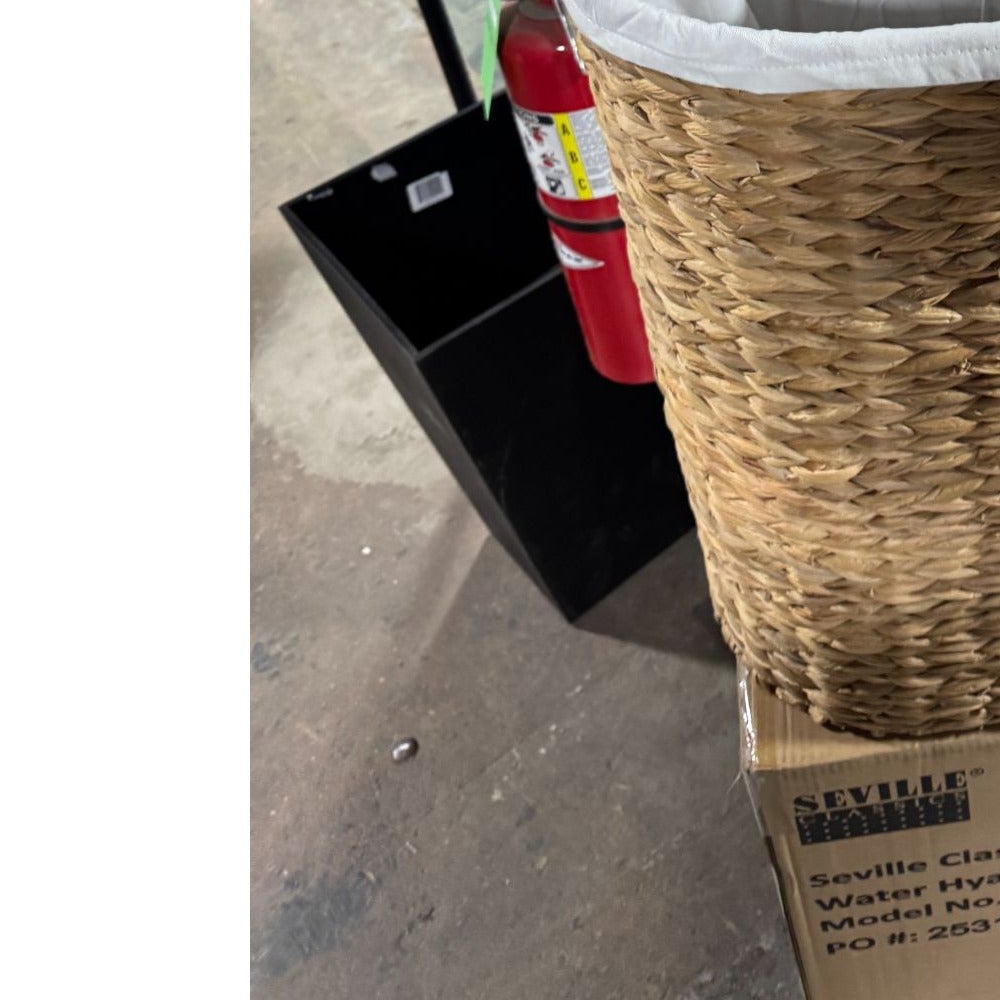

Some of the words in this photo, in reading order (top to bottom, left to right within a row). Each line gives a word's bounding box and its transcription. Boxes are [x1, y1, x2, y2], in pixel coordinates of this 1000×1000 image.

[561, 123, 571, 136] A
[570, 152, 579, 164] B
[578, 178, 588, 190] C
[809, 860, 928, 888] Seville
[815, 883, 928, 911] Water
[820, 903, 933, 932] Model
[826, 937, 876, 955] PO
[887, 931, 918, 945] #:
